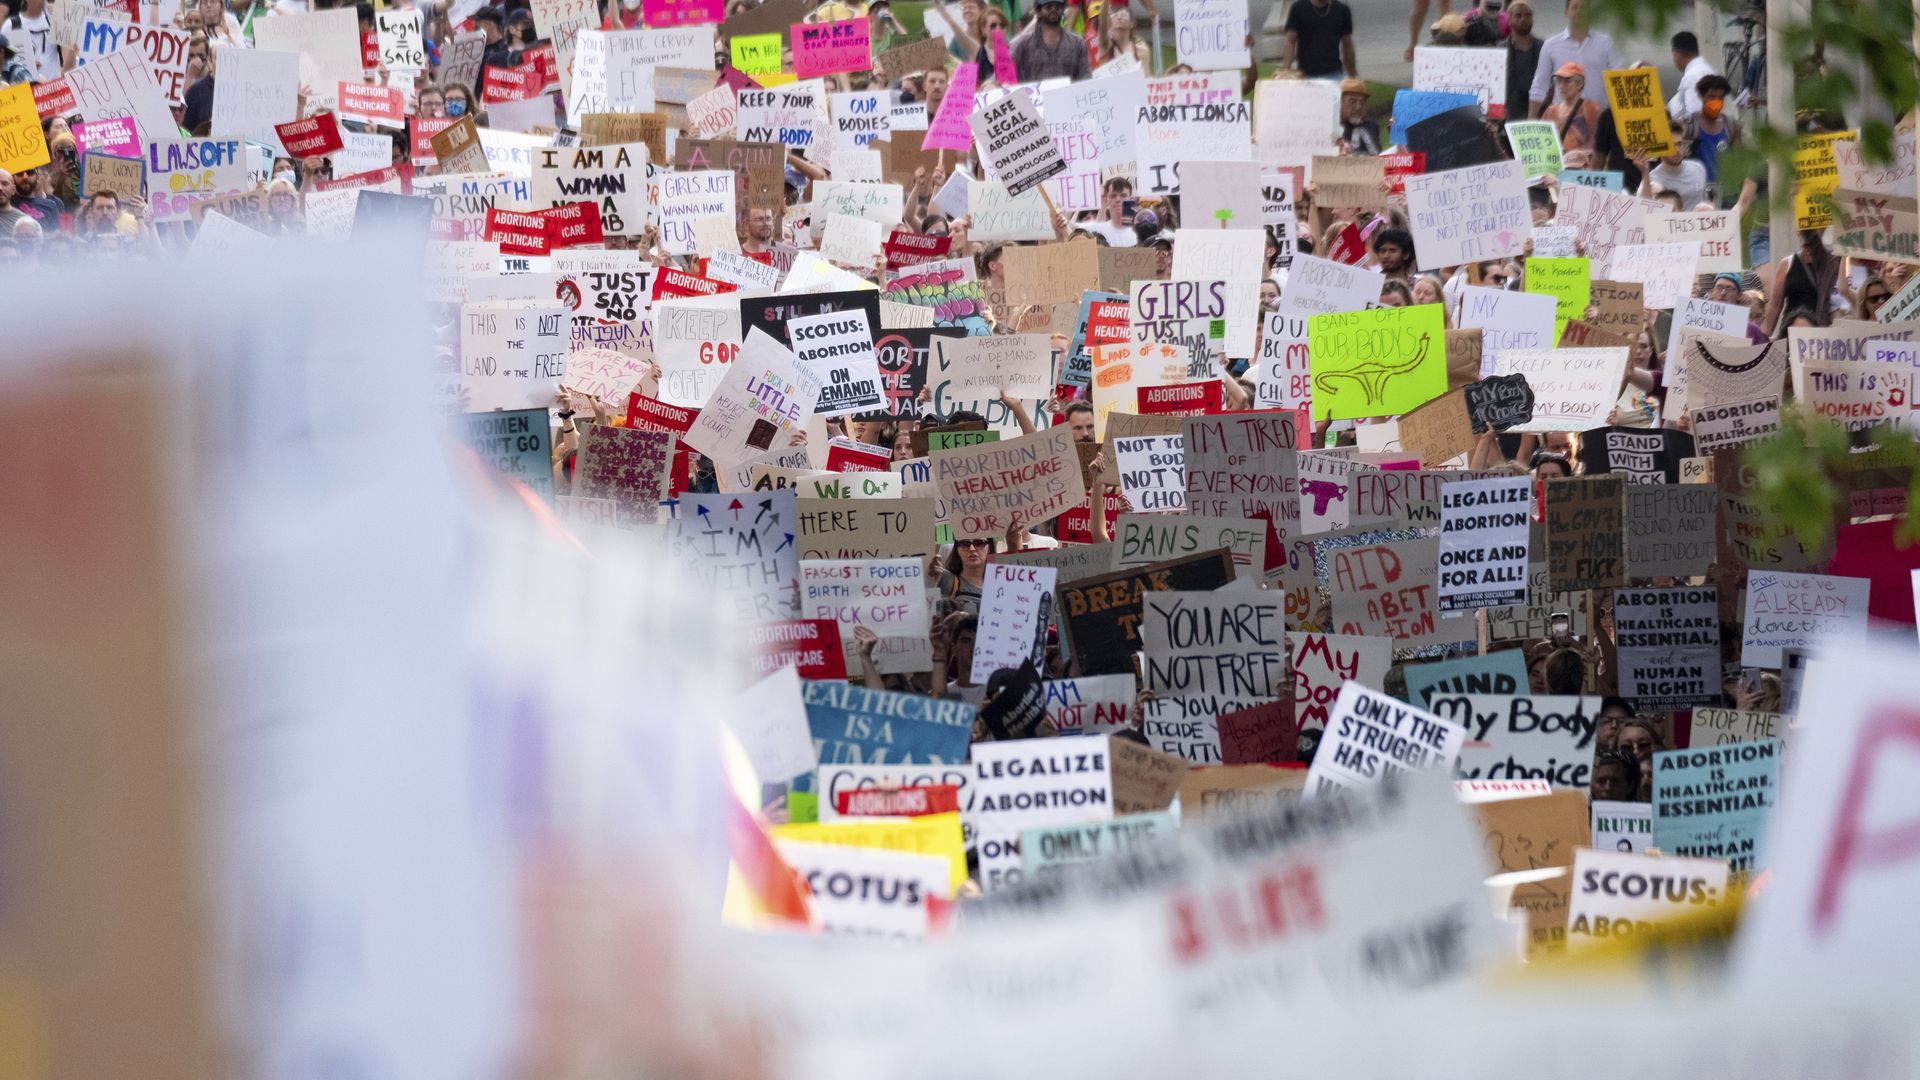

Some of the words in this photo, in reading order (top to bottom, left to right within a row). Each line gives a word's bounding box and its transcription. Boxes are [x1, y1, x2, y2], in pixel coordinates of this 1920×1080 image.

[83, 21, 124, 54] MY
[802, 26, 854, 41] MAKE
[804, 40, 827, 48] COAT
[489, 70, 525, 85] ABORTIONS
[1147, 82, 1173, 93] THIS
[1178, 78, 1208, 90] WAS
[346, 83, 389, 98] ABORTIONS
[486, 86, 525, 100] HEALTHCARE
[1626, 86, 1650, 98] BACK
[345, 99, 390, 113] HEALTHCARE
[740, 93, 772, 108] KEEP
[781, 94, 815, 109] YOUR
[850, 99, 877, 114] OUR
[1631, 97, 1653, 108] WILL
[764, 113, 798, 127] LAWS
[984, 100, 1016, 123] SAFE
[85, 121, 123, 133] PROTECT
[109, 126, 132, 138] LEGAL
[281, 120, 318, 136] ABORTIONS
[840, 116, 890, 130] BODIES
[986, 112, 1028, 139] LEGAL
[1510, 126, 1552, 136] OVERTURN
[1625, 119, 1651, 133] FIGHT
[746, 128, 773, 142] MY
[988, 120, 1040, 154] ABORTION
[573, 149, 603, 168] AM
[615, 147, 631, 168] A
[994, 157, 1011, 170] ON
[1011, 136, 1051, 161] DEMAND
[1521, 154, 1543, 165] HELL
[1001, 172, 1014, 183] NO
[1014, 147, 1058, 177] APOLOGIES!
[170, 171, 216, 192] OUR
[1440, 173, 1457, 186] MY
[1466, 166, 1511, 182] UTERUS
[1576, 175, 1607, 187] SAFE
[1875, 163, 1916, 186] 2022
[556, 173, 626, 196] WOMAN
[664, 176, 701, 198] GIRLS
[704, 176, 730, 193] JUST
[865, 189, 888, 205] this
[1854, 197, 1888, 215] MY
[663, 206, 700, 215] WANNA
[702, 203, 725, 213] HAVE
[494, 213, 545, 229] ABORTIONS
[973, 213, 1000, 231] MY
[1000, 211, 1051, 233] CHOICE
[1418, 210, 1464, 229] BULLETS
[491, 231, 544, 249] HEALTHCARE
[894, 235, 936, 249] ABORTIONS
[1436, 227, 1459, 241] NOT
[504, 260, 530, 271] THE
[1300, 260, 1354, 289] ABORTION
[1552, 264, 1582, 278] hardest
[665, 270, 718, 294] ABORTIONS
[1532, 280, 1571, 291] decision
[594, 292, 638, 309] SAY
[1138, 281, 1226, 320] GIRLS
[1472, 295, 1499, 320] MY
[606, 308, 637, 321] NO
[1317, 313, 1360, 331] BANS
[1375, 307, 1404, 322] OFF
[1700, 304, 1725, 316] GUN
[467, 313, 497, 335] THIS
[515, 317, 526, 331] IS
[537, 314, 562, 334] NOT
[666, 307, 728, 341] KEEP
[794, 320, 864, 342] SCOTUS:
[1133, 320, 1188, 342] JUST
[1685, 316, 1723, 330] SHOULD
[507, 340, 524, 349] THE
[798, 341, 872, 361] ABORTION
[977, 336, 1027, 348] ABORTION
[1313, 334, 1348, 358] OUR
[1355, 326, 1418, 360] BODYS
[466, 356, 497, 377] LAND
[514, 370, 528, 378] THE
[534, 353, 564, 379] FREE
[965, 353, 981, 364] ON
[988, 351, 1037, 362] DEMAND
[1509, 358, 1552, 372] KEEP
[1562, 358, 1605, 370] YOUR
[830, 367, 851, 384] ON
[964, 374, 1005, 386] WITHOUT
[1009, 374, 1044, 387] APOLOGY
[1811, 372, 1848, 391] THIS
[745, 375, 801, 422] LITTLE
[1147, 386, 1204, 403] ABORTIONS
[636, 398, 688, 423] ABORTIONS
[748, 397, 770, 416] BOOK
[1532, 402, 1554, 416] MY
[1560, 400, 1601, 415] BODY
[1695, 400, 1778, 424] ABORTION
[1733, 419, 1743, 429] IS
[516, 435, 540, 452] GO
[1190, 421, 1228, 454] I'M
[1236, 419, 1296, 452] TIRED
[1608, 434, 1661, 449] STAND
[1117, 438, 1153, 454] NOT
[939, 447, 1036, 480] ABORTION
[1228, 454, 1247, 466] OF
[1610, 453, 1651, 469] WITH
[1122, 468, 1166, 490] NOT
[1187, 470, 1296, 494] EVERYONE
[951, 487, 1033, 515] ABORTION
[1443, 487, 1529, 508] LEGALIZE
[800, 509, 858, 536] HERE
[877, 511, 907, 534] TO
[962, 514, 1005, 534] OUR
[1442, 512, 1527, 533] ABORTION
[701, 528, 763, 558] I'M
[1122, 523, 1200, 559] BANS
[1440, 548, 1485, 566] ONCE
[1488, 545, 1526, 561] AND
[804, 566, 864, 580] FASCIST
[870, 567, 920, 579] FORCED
[994, 566, 1038, 582] FUCK
[1335, 546, 1402, 592] AID
[1441, 569, 1478, 587] FOR
[1481, 565, 1523, 585] ALL!
[808, 586, 849, 598] BIRTH
[862, 585, 905, 598] SCUM
[1780, 577, 1836, 591] we've
[1616, 591, 1717, 607] ABORTION
[1754, 592, 1850, 614] ALREADY
[871, 604, 910, 622] OFF
[1660, 608, 1673, 617] IS
[1149, 598, 1214, 650] YOU
[1219, 603, 1278, 646] ARE
[1295, 634, 1360, 680] My
[1149, 656, 1214, 693] NOT
[1216, 652, 1280, 698] FREE
[1634, 666, 1702, 681] HUMAN
[1636, 680, 1704, 696] RIGHT!
[1094, 703, 1127, 725] AN
[1353, 694, 1404, 729] ONLY
[1408, 714, 1449, 751] THE
[1508, 694, 1601, 750] Body
[1695, 709, 1739, 729] STOP
[1745, 713, 1781, 737] THE
[844, 714, 872, 739] IS
[874, 721, 894, 745] A
[1147, 720, 1205, 740] DECIDE
[1334, 741, 1379, 779] HAS
[1660, 743, 1774, 771] ABORTION
[976, 754, 1105, 779] LEGALIZE
[1710, 768, 1725, 780] IS
[980, 788, 1107, 813] ABORTION
[1597, 816, 1652, 833] RUTH
[1676, 838, 1754, 858] HUMAN
